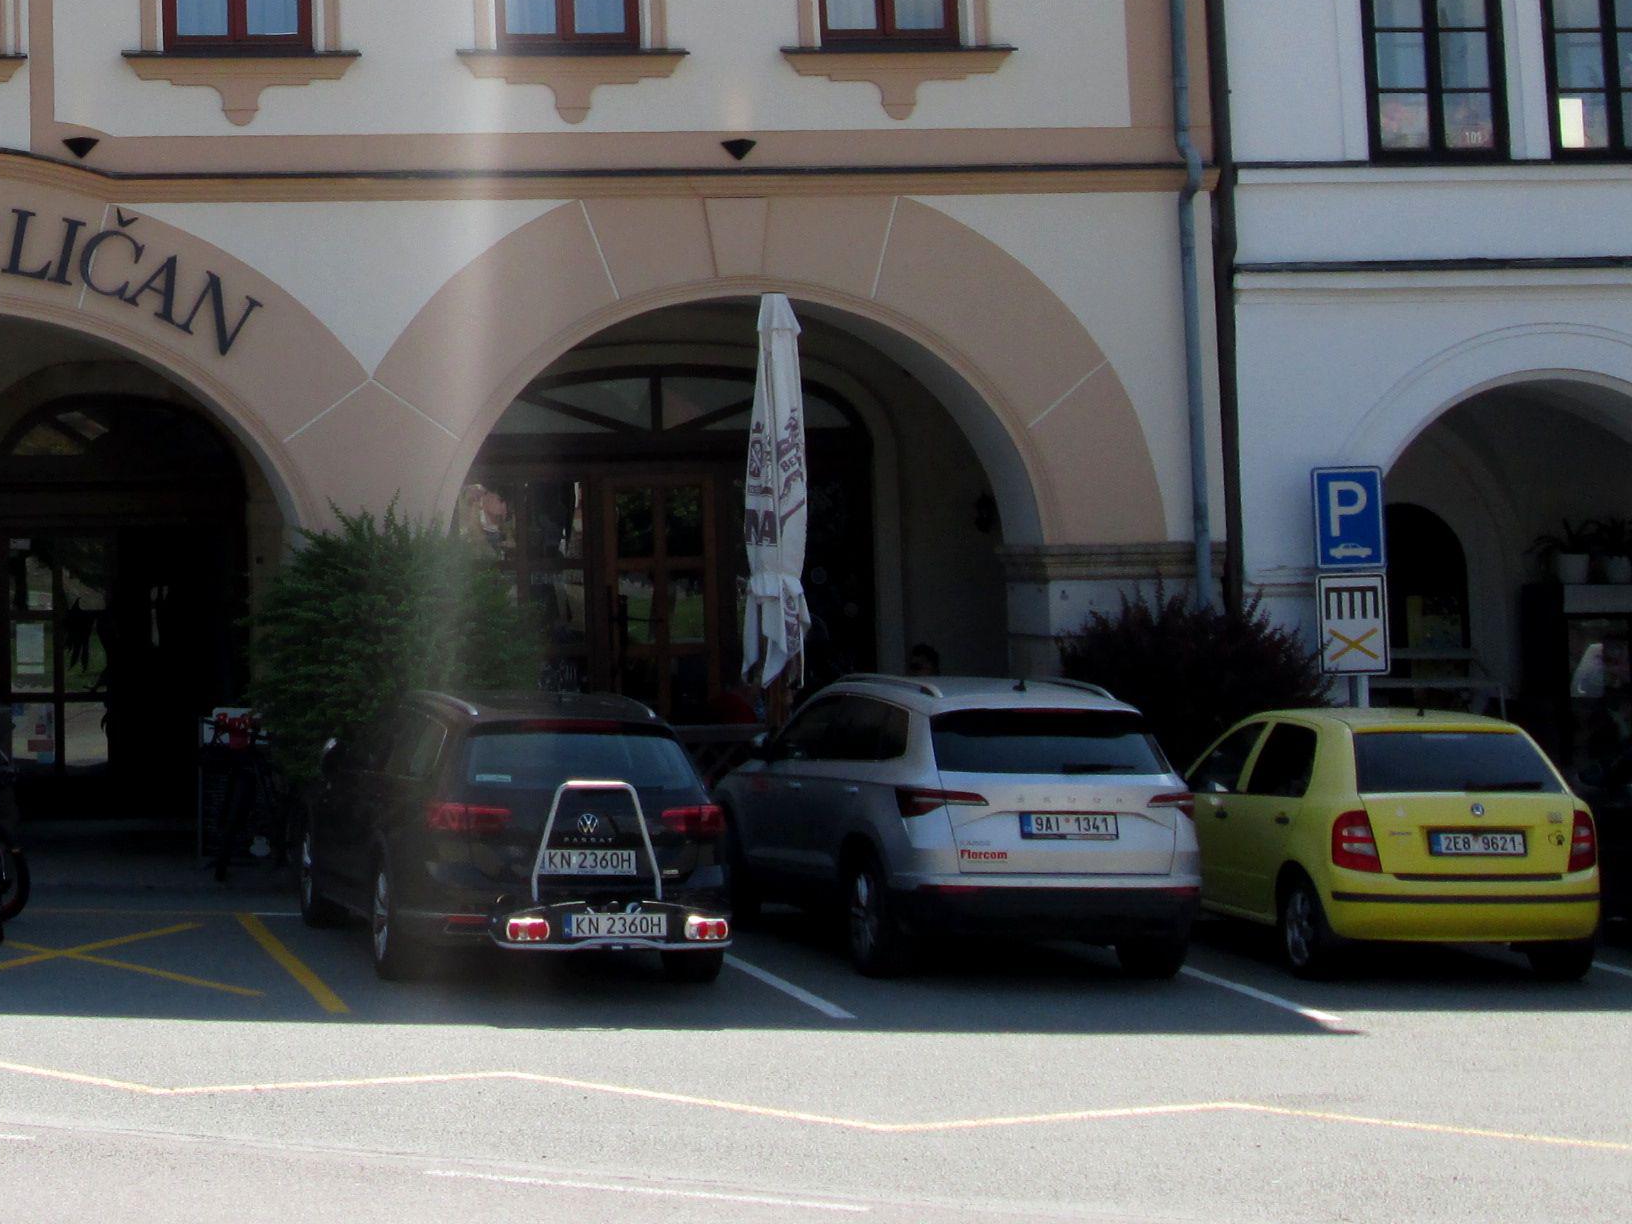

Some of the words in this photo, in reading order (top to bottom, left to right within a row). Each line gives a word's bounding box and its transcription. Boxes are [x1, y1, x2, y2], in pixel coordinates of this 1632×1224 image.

[1328, 480, 1367, 537] P
[1075, 817, 1109, 832] 1341
[1445, 836, 1470, 851] 2E8
[1482, 837, 1517, 851] 9621
[548, 853, 571, 868] KN
[578, 853, 631, 869] 2360H
[575, 917, 599, 934] KN
[606, 917, 662, 934] 2360H
